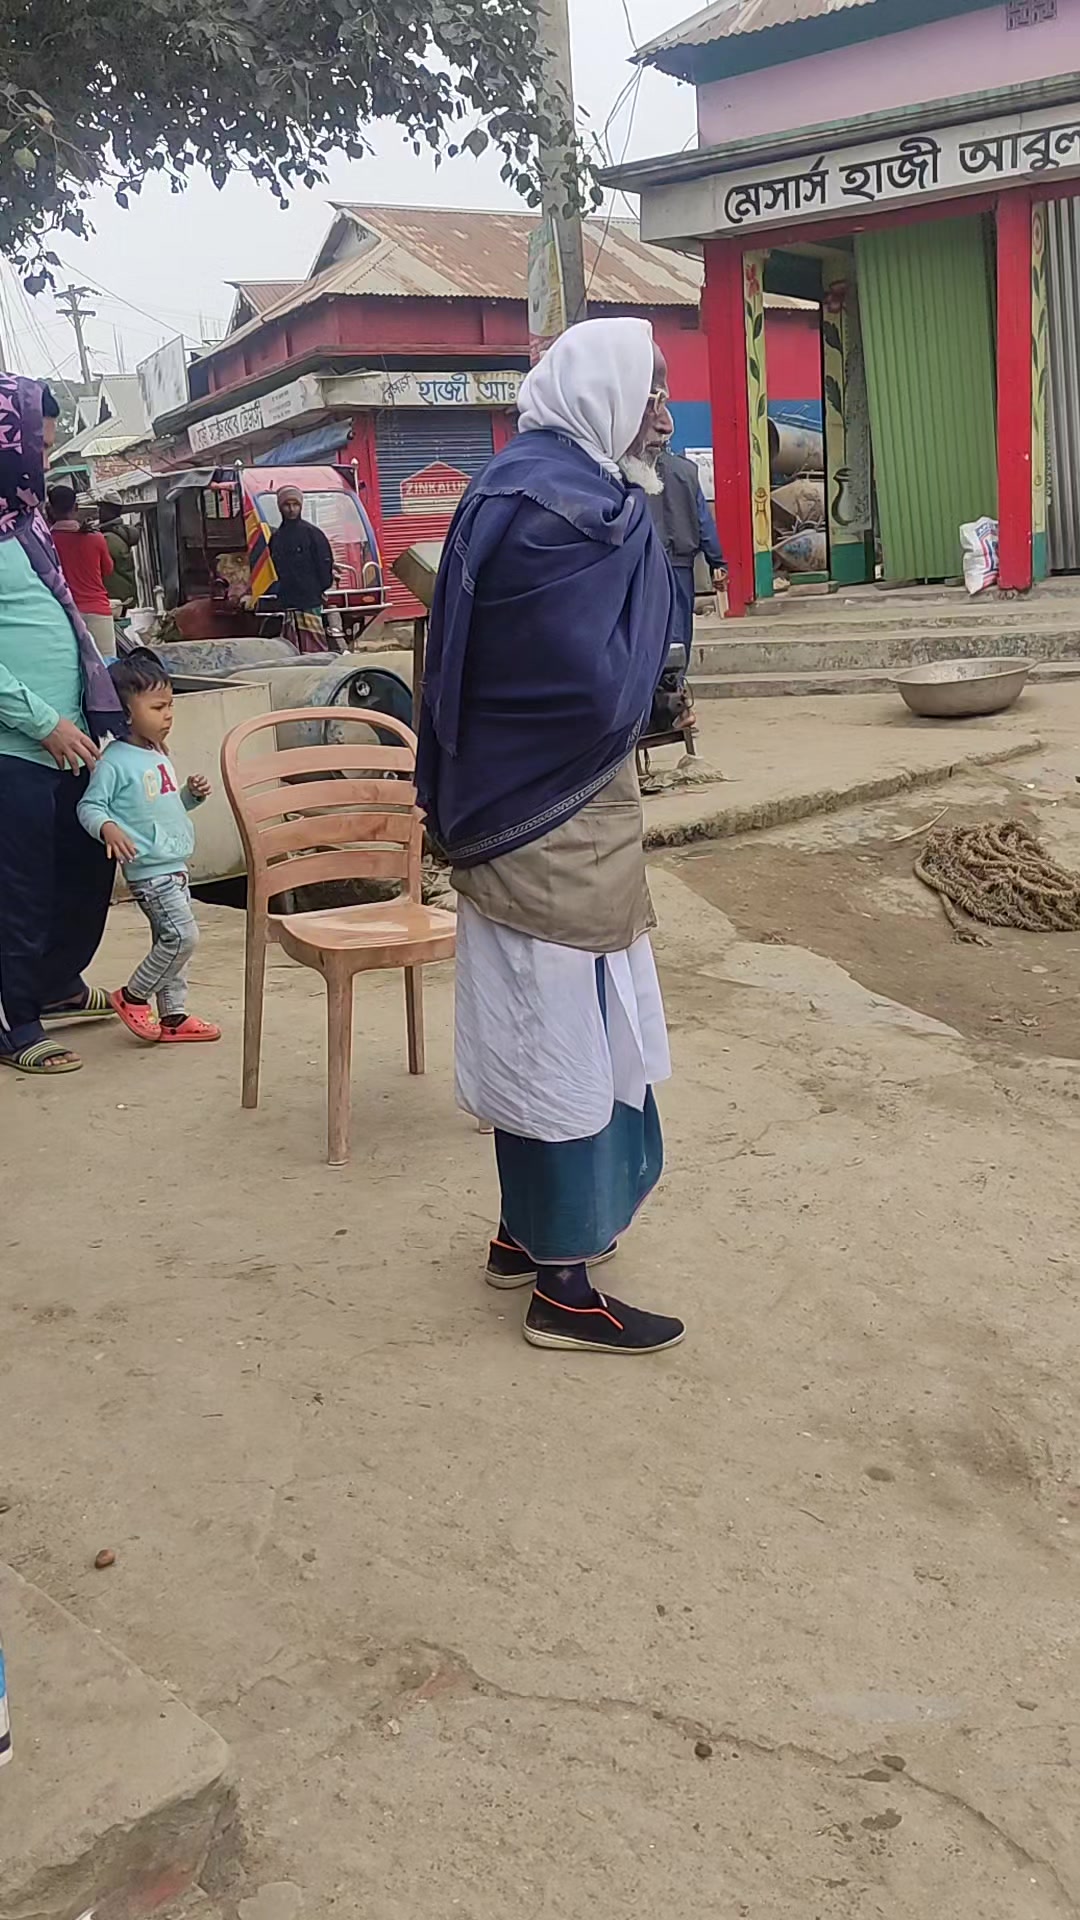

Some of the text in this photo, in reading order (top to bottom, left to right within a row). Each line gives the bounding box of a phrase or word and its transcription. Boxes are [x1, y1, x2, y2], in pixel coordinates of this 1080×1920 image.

[725, 156, 829, 224] মেসার্স
[839, 137, 941, 201] হাজী
[416, 373, 470, 405] হাজী
